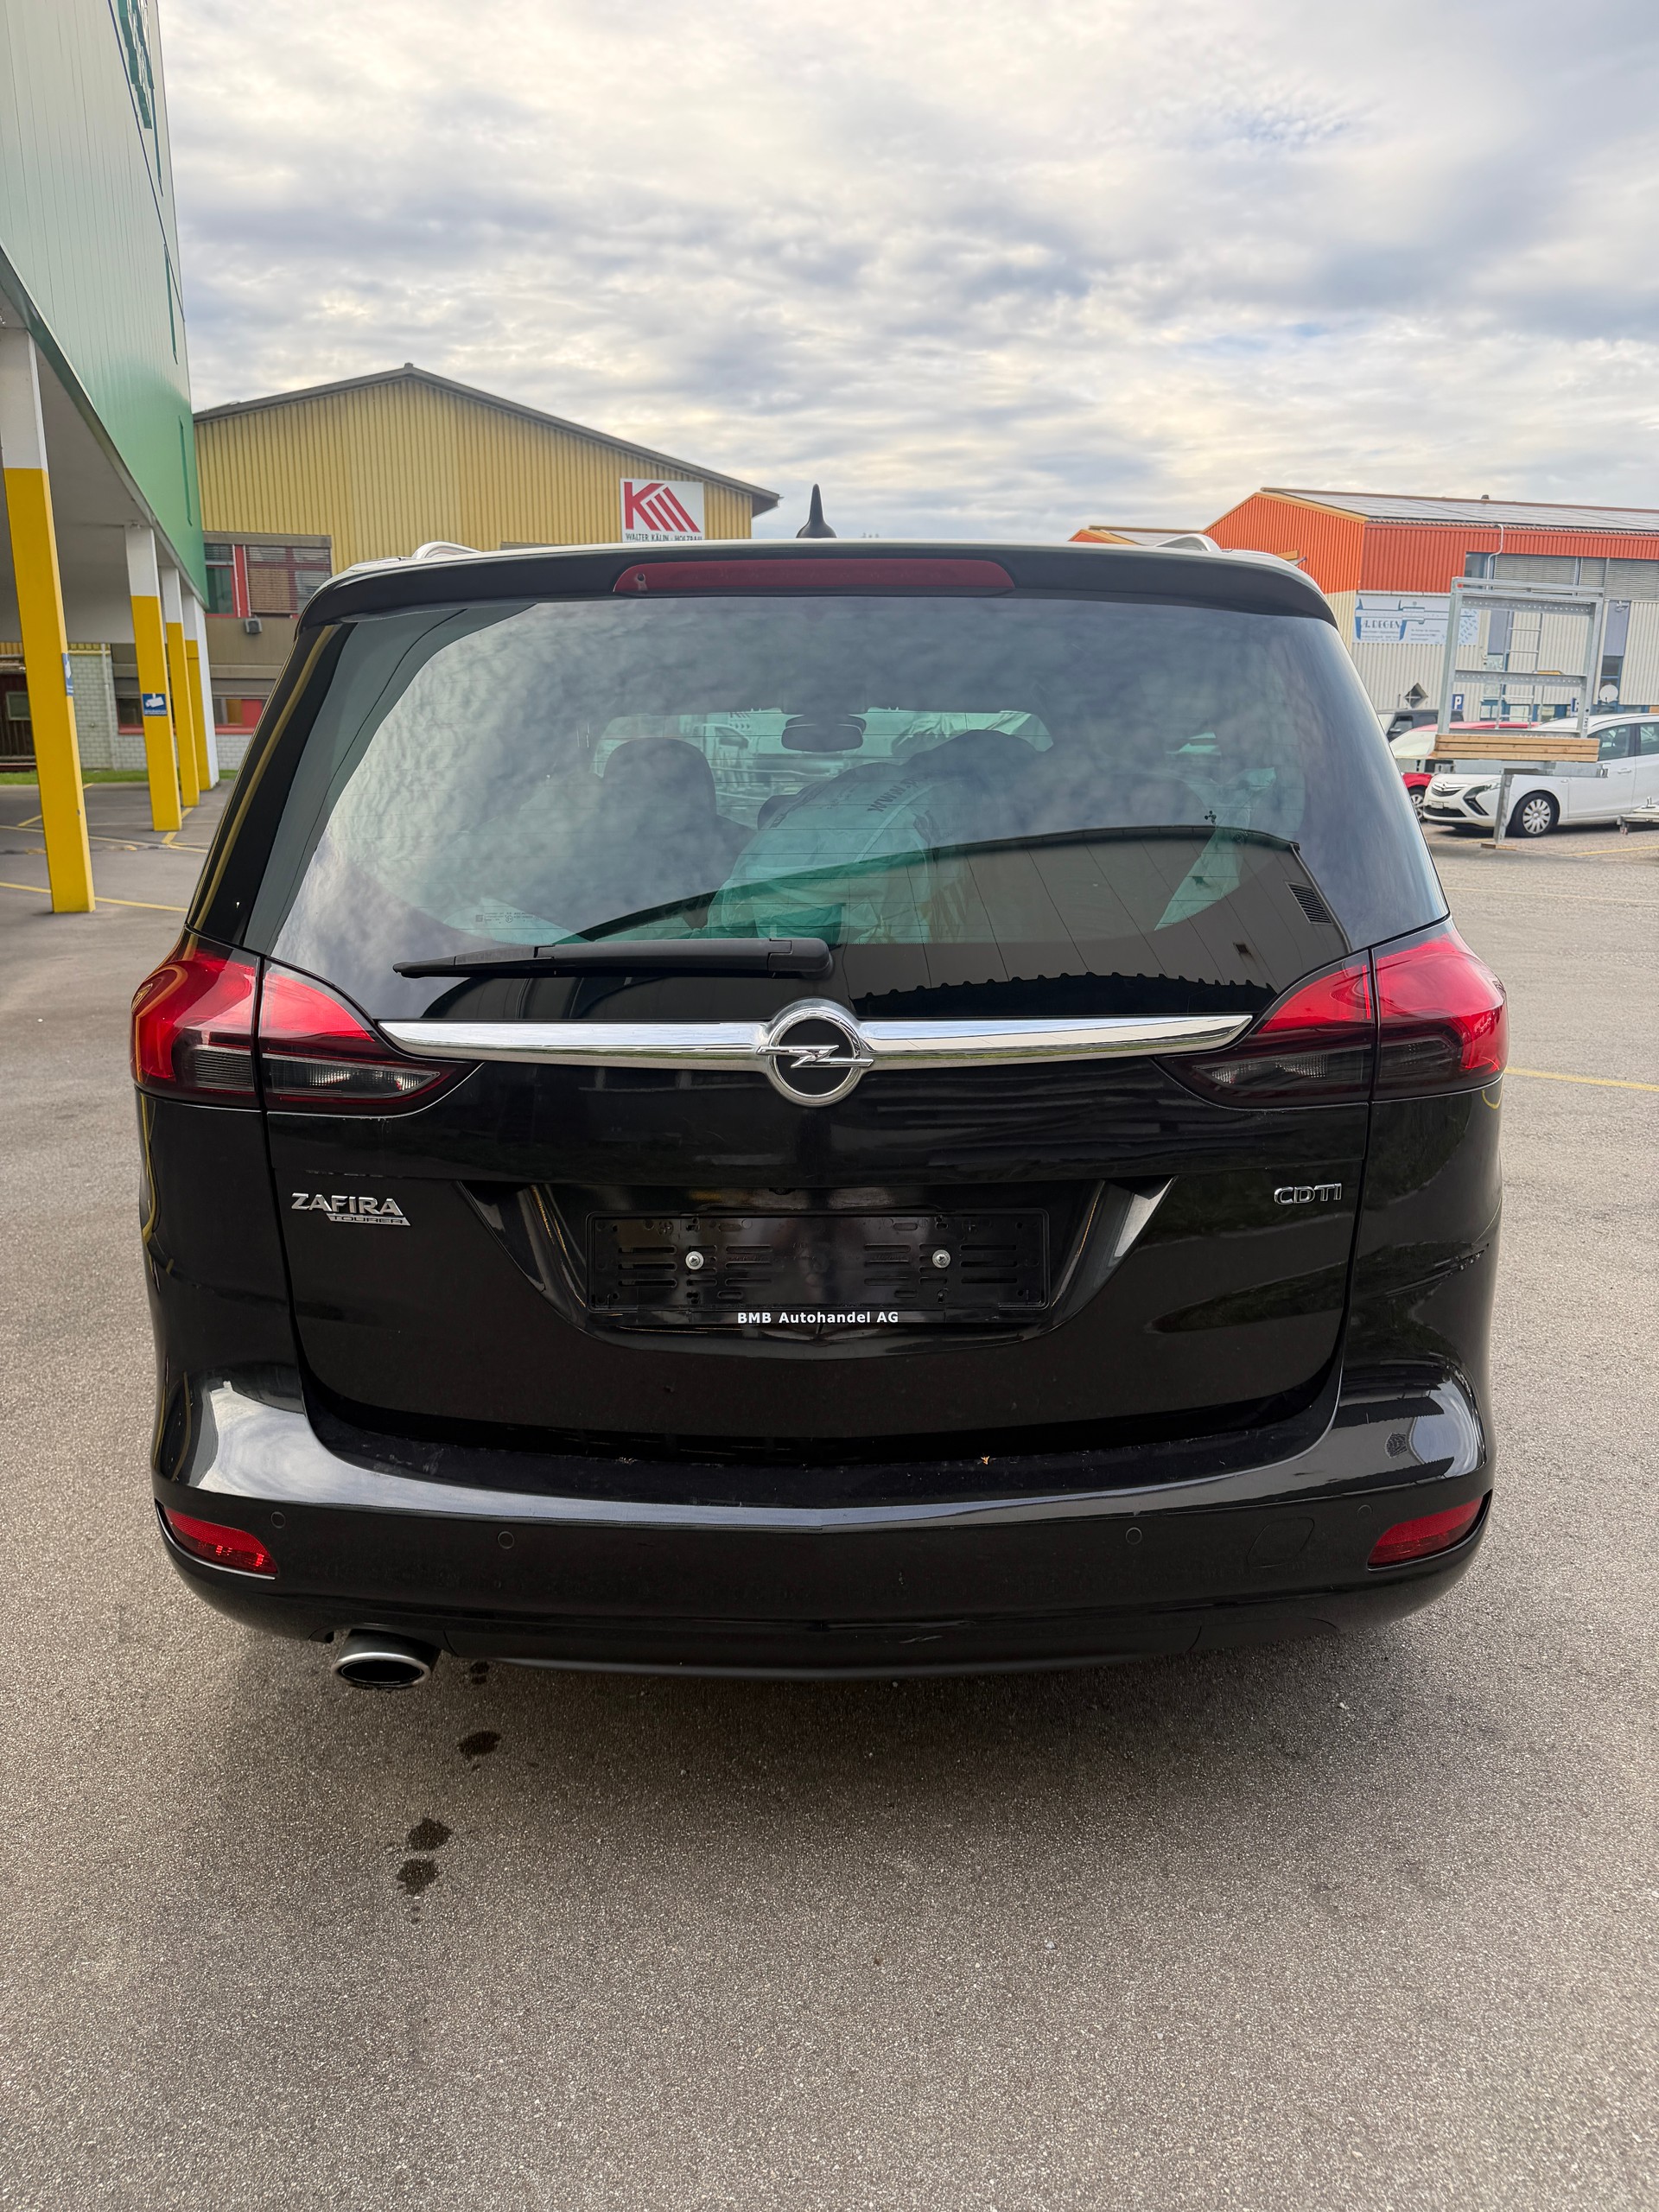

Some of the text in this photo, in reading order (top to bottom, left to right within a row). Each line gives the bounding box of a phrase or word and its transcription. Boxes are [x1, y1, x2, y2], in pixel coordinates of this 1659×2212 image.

[626, 532, 648, 542] WALTER
[1372, 620, 1400, 629] DEGEN
[1454, 696, 1462, 709] P
[1274, 1183, 1342, 1205] CDTI
[291, 1192, 404, 1217] ZAFIRA
[334, 1215, 404, 1224] TOURER
[737, 1311, 899, 1324] BMB Autohandel AG
